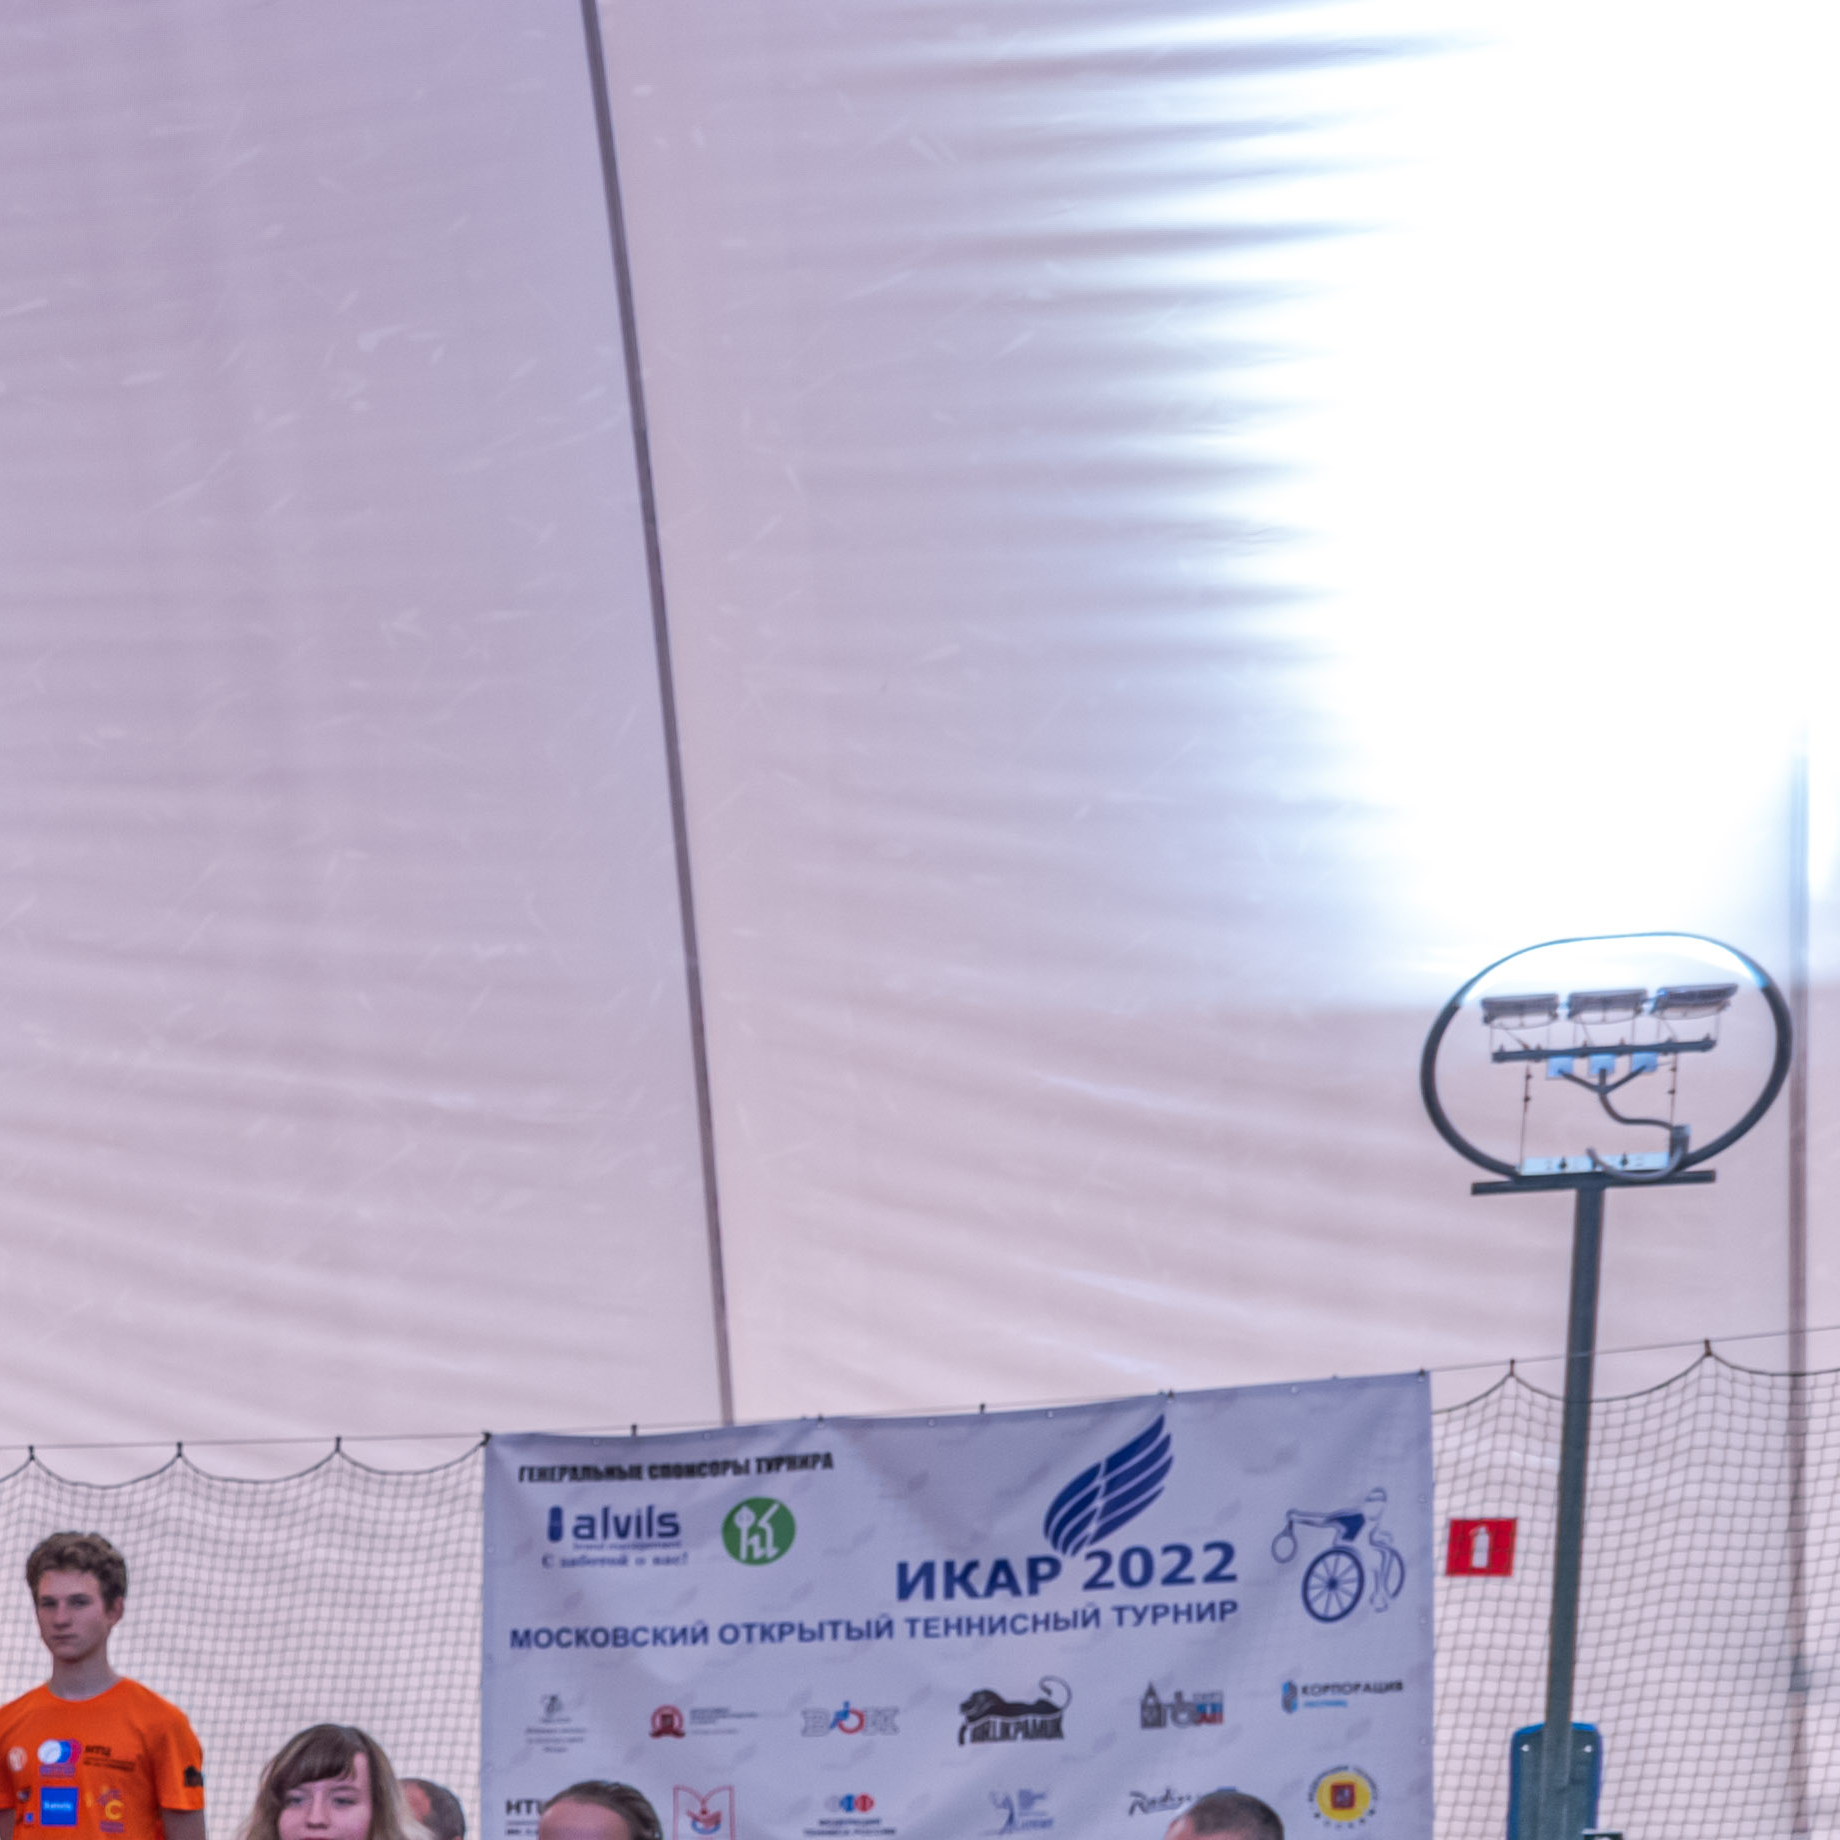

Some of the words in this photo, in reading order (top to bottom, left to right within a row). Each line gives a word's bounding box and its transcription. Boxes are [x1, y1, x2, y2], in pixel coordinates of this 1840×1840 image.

[519, 1464, 643, 1483] ГЕНЕРАЛЬНЫЕ
[648, 1458, 750, 1481] СПОНСОРЫ
[755, 1451, 834, 1475] ТУРНИРА
[896, 1554, 1062, 1602] ИКАР
[1082, 1540, 1239, 1592] 2022
[510, 1620, 709, 1650] МОСКОВСКИЙ
[718, 1612, 894, 1645] ОТКРЫТЫЙ
[905, 1601, 1102, 1638] ТЕННИСНЫЙ
[1112, 1599, 1239, 1627] ТУРНИР
[1302, 1680, 1403, 1697] КОРПОРАЦИЯ
